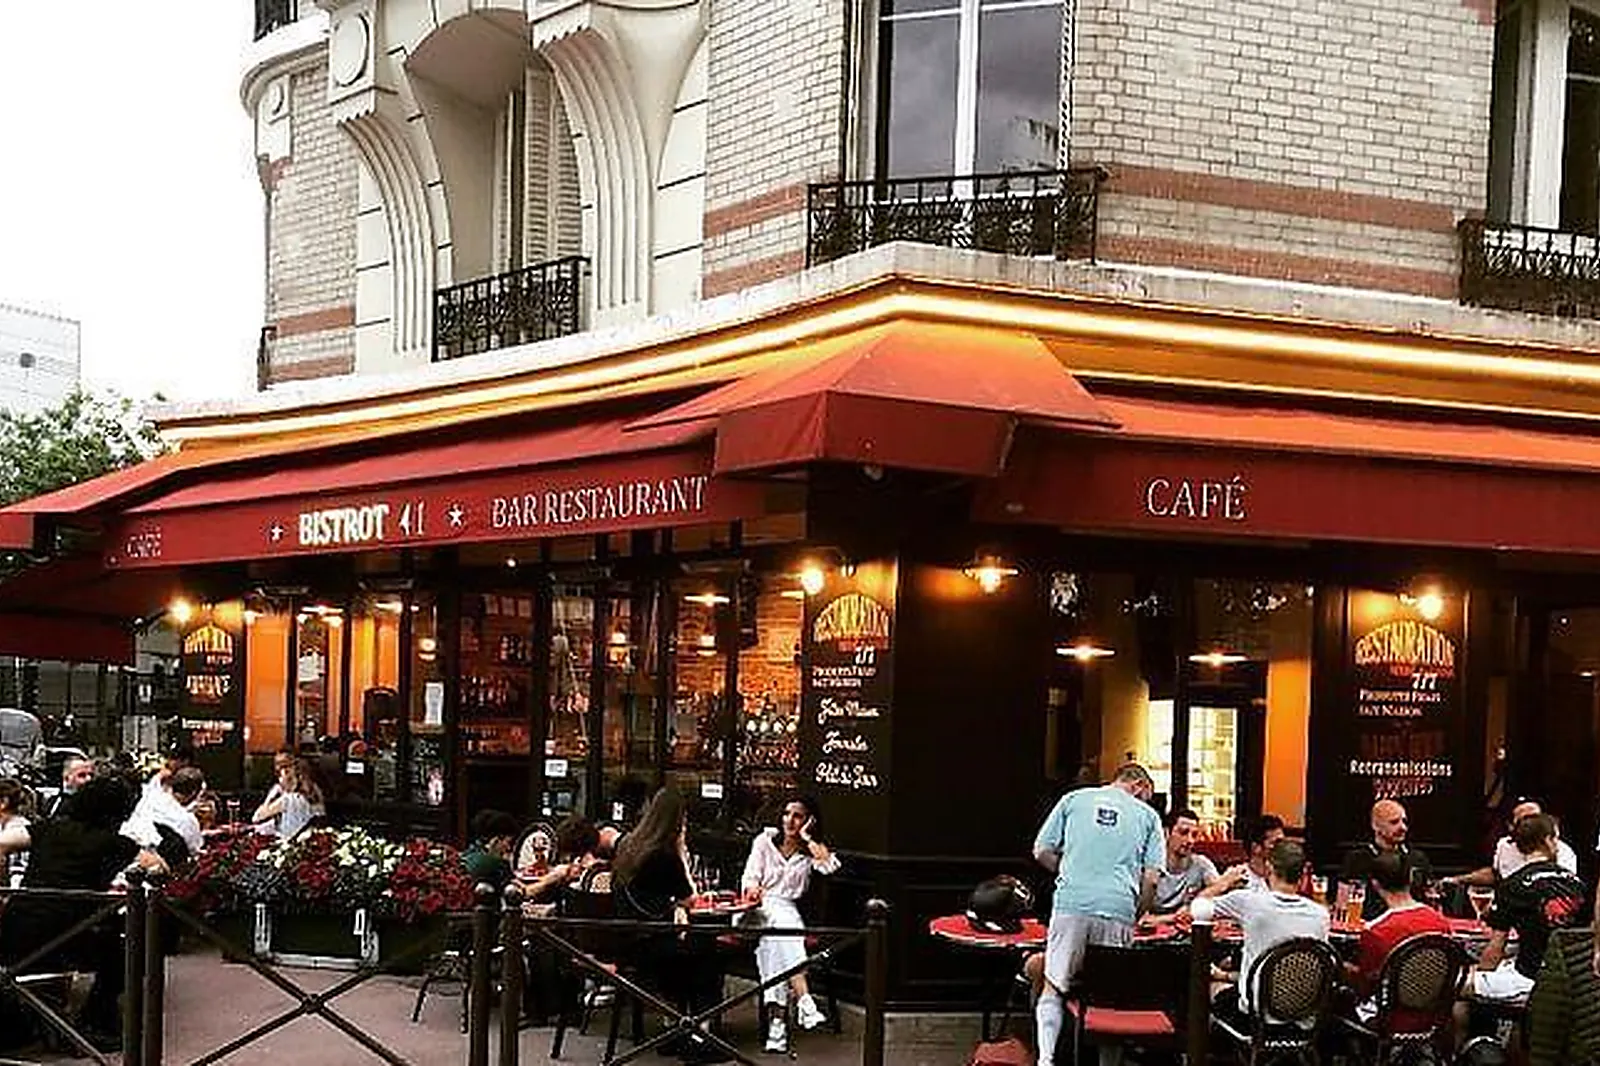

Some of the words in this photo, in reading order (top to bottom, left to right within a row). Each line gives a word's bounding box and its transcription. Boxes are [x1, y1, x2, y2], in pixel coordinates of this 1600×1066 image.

[491, 492, 538, 529] BAR
[544, 475, 708, 526] RESTAURANT
[1147, 475, 1247, 519] CAFÉ
[299, 503, 390, 546] BISTROT
[399, 500, 425, 536] 41
